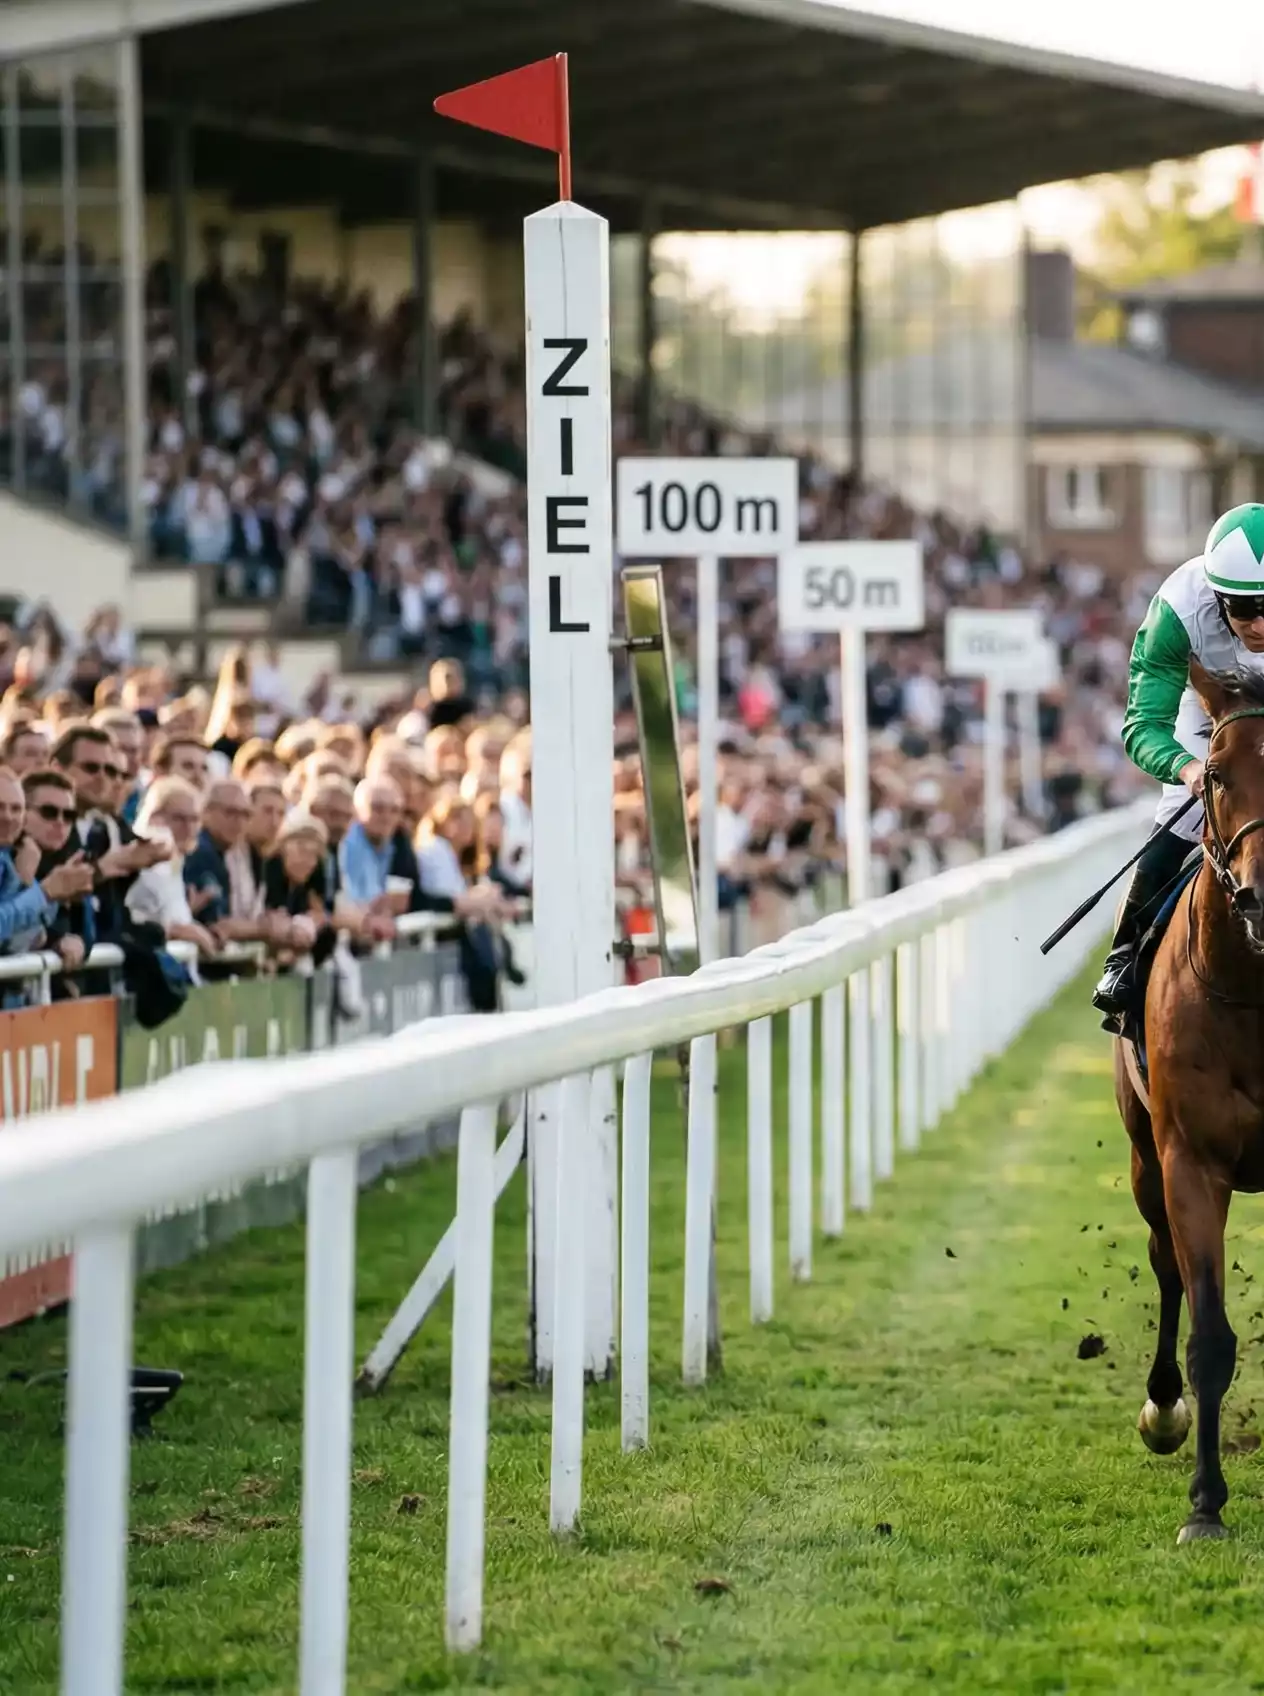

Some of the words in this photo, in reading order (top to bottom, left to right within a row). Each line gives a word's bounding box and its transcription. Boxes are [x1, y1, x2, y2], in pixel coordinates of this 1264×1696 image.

[542, 338, 590, 632] ZIEL
[634, 481, 722, 533] 100
[736, 496, 778, 532] m
[804, 565, 856, 610] 50
[863, 577, 900, 608] m
